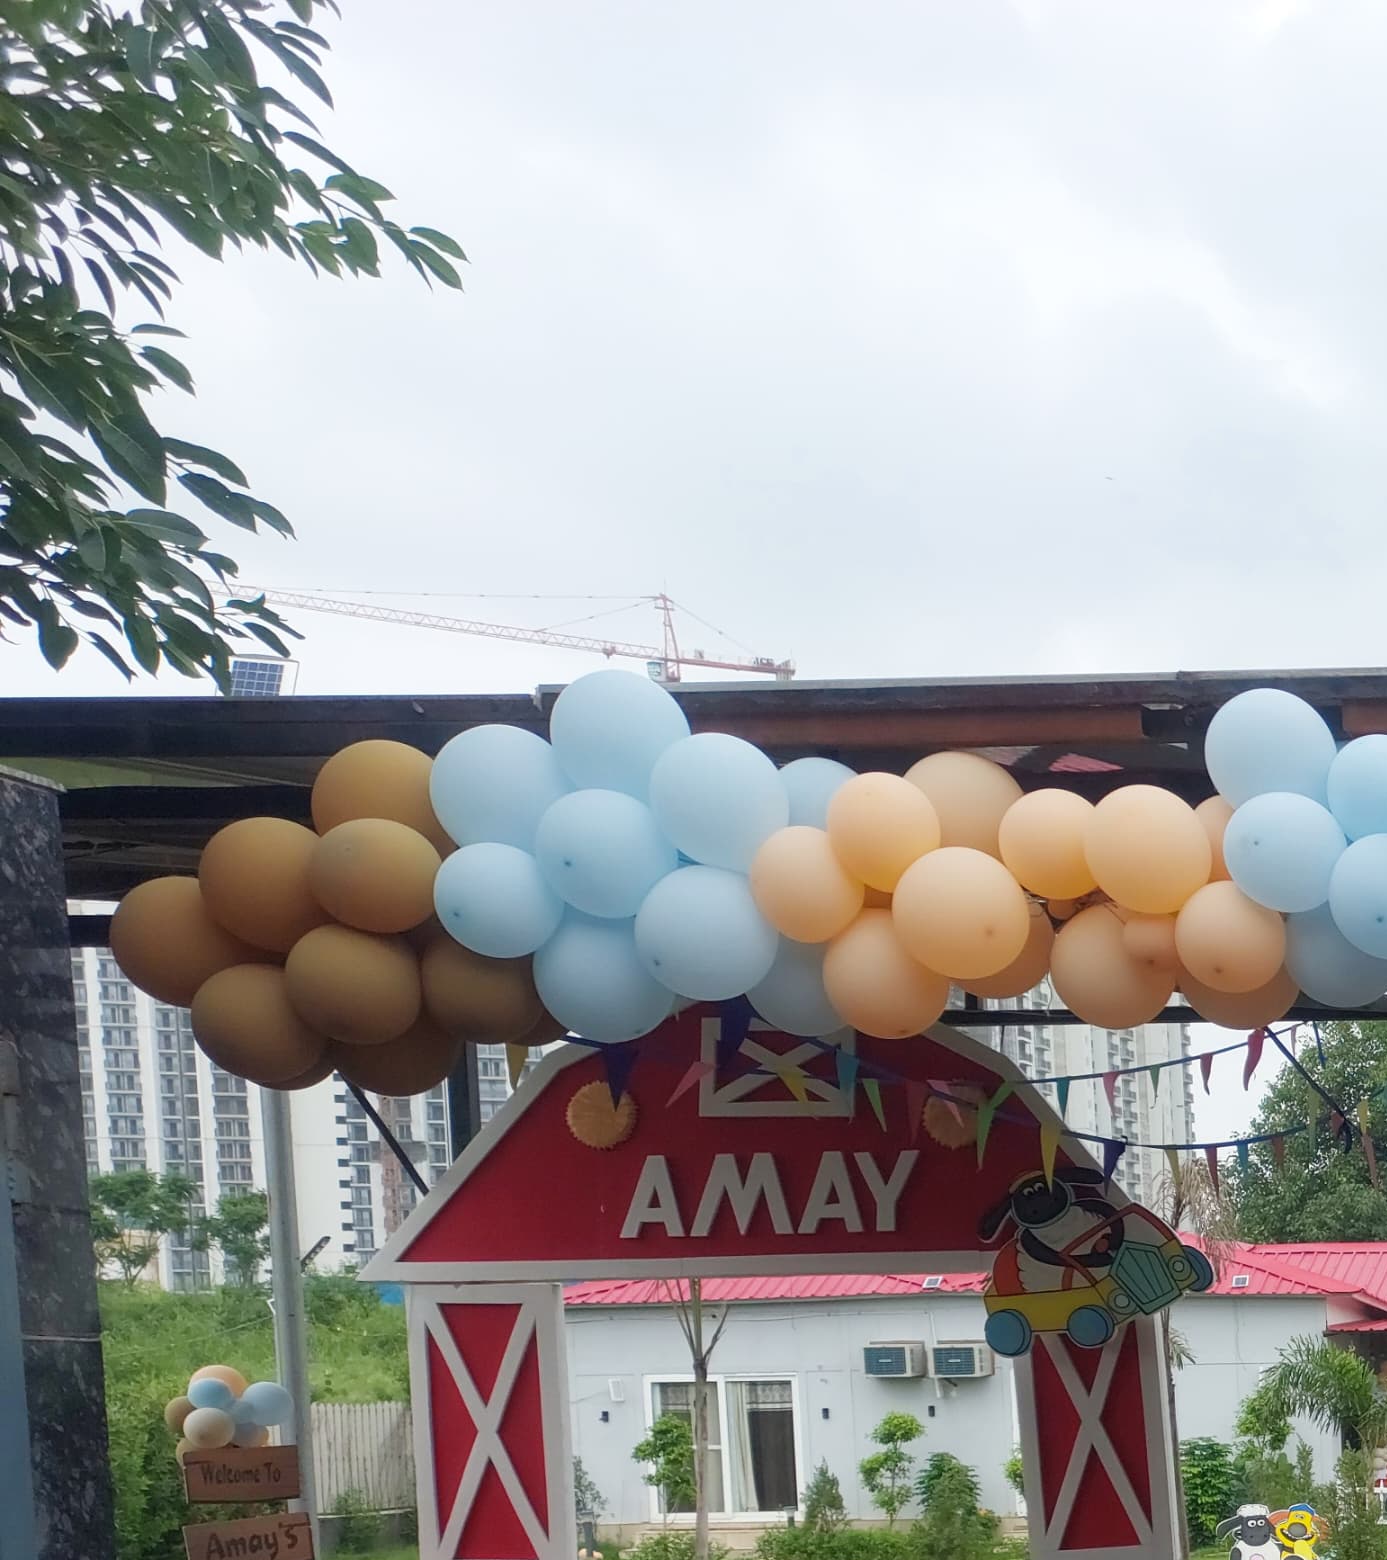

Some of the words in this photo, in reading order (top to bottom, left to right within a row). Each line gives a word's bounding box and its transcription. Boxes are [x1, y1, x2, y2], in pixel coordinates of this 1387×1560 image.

[619, 1149, 921, 1239] AMAY
[200, 1463, 261, 1485] Welcome
[263, 1462, 282, 1483] To
